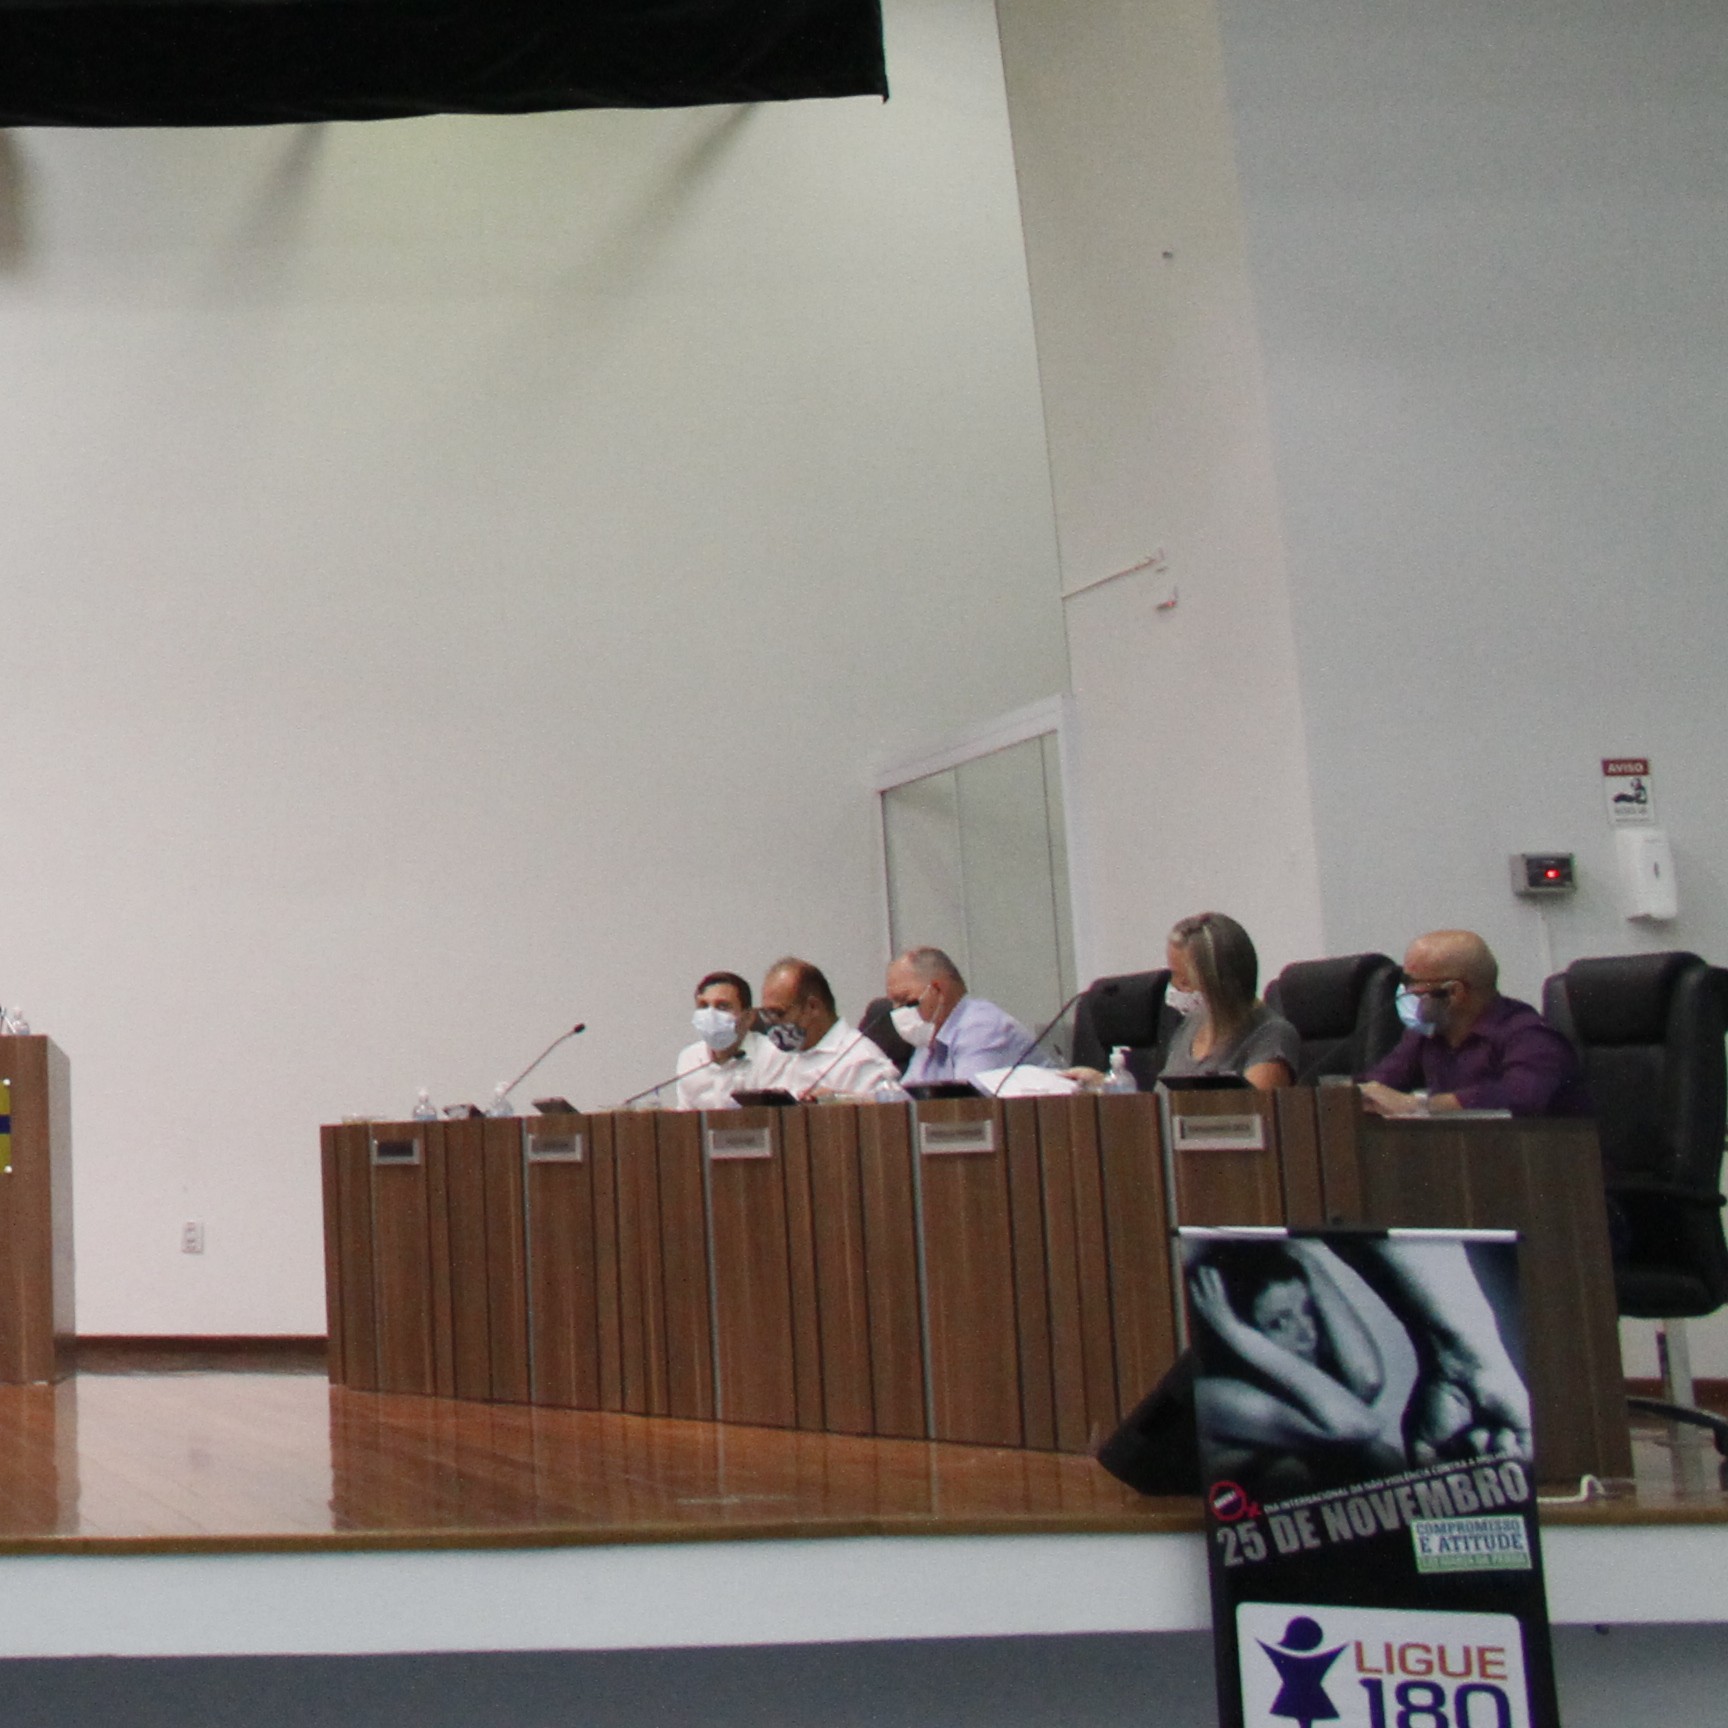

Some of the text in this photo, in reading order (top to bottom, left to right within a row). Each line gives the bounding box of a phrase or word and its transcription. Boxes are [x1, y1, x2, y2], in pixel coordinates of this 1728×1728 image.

[1607, 762, 1645, 773] AVISO
[1217, 1462, 1529, 1566] 25 DE NOVEMBRO
[1417, 1520, 1521, 1534] COMPROMISSO
[1419, 1533, 1523, 1553] E ATITUDE
[1355, 1640, 1508, 1680] LIGUE
[1358, 1677, 1511, 1728] 180
